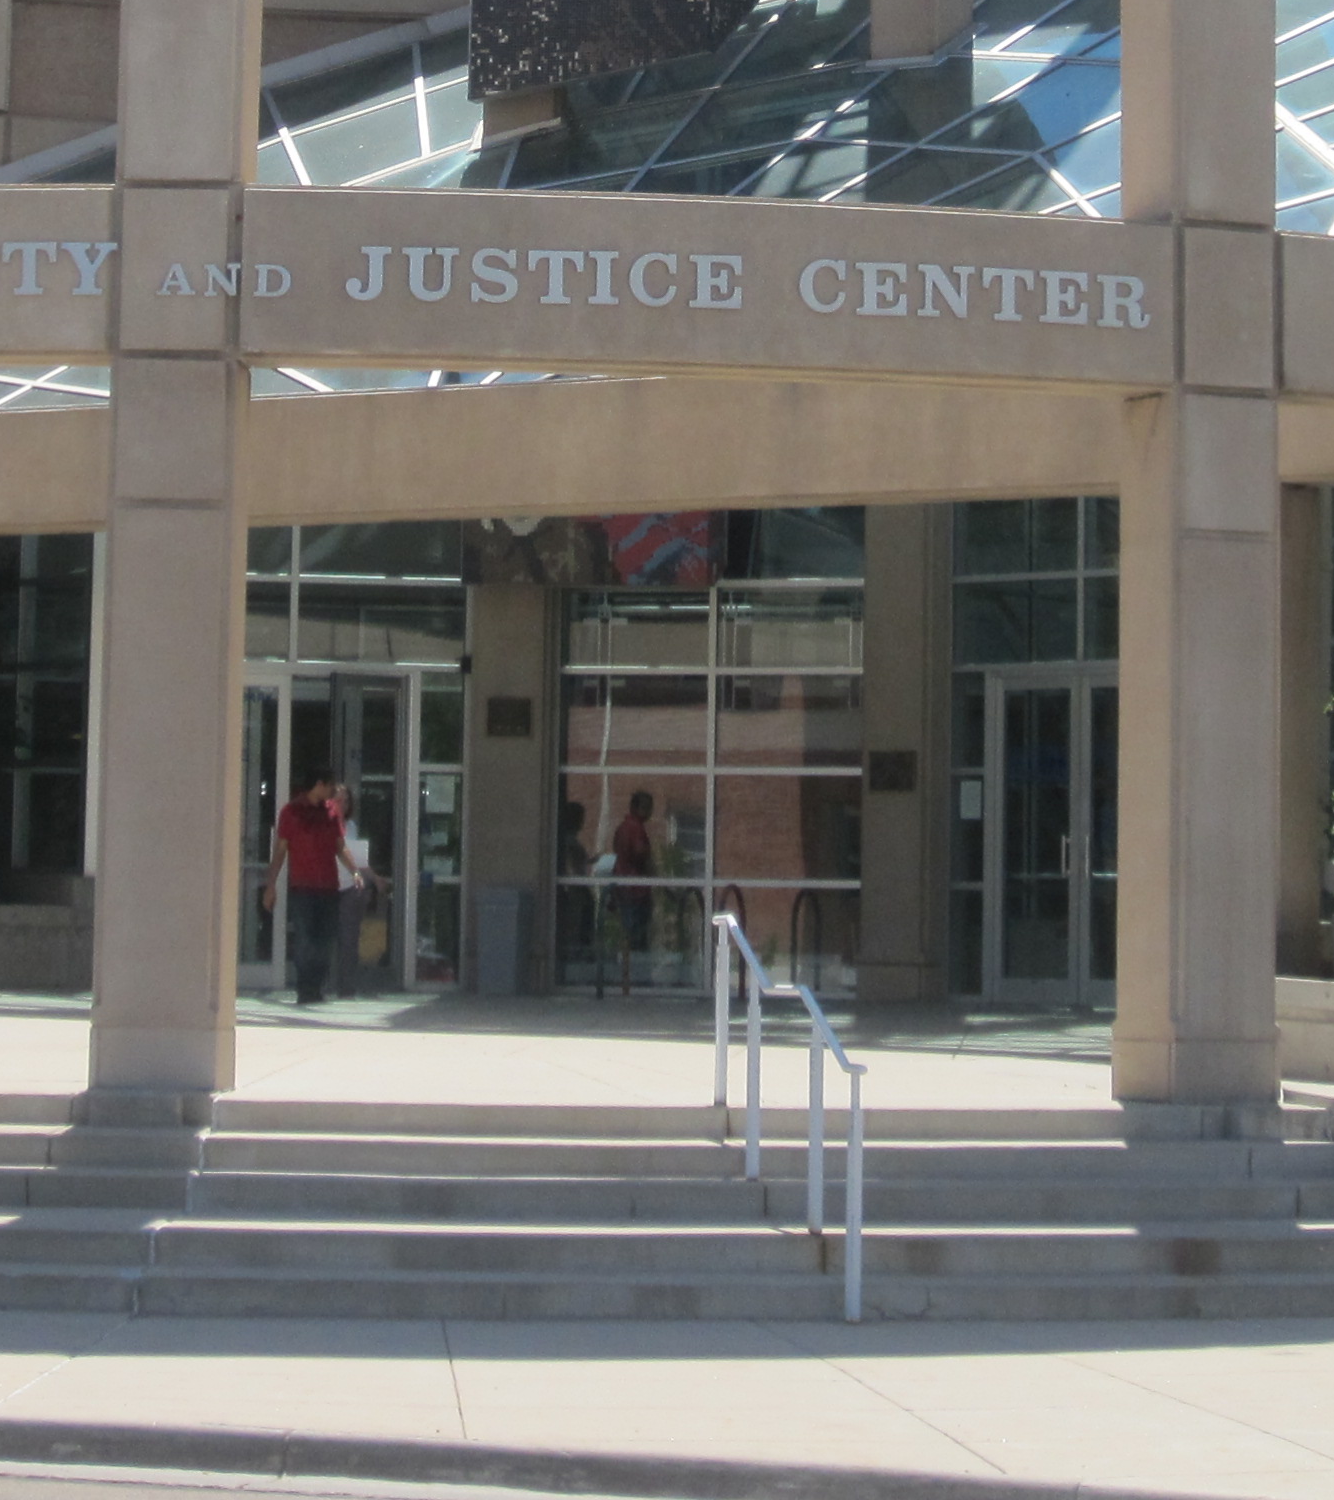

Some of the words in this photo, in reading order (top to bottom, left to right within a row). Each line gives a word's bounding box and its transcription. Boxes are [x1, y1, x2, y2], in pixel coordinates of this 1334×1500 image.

[157, 262, 293, 297] AND
[345, 245, 743, 310] JUSTICE
[798, 258, 1151, 330] CENTER
